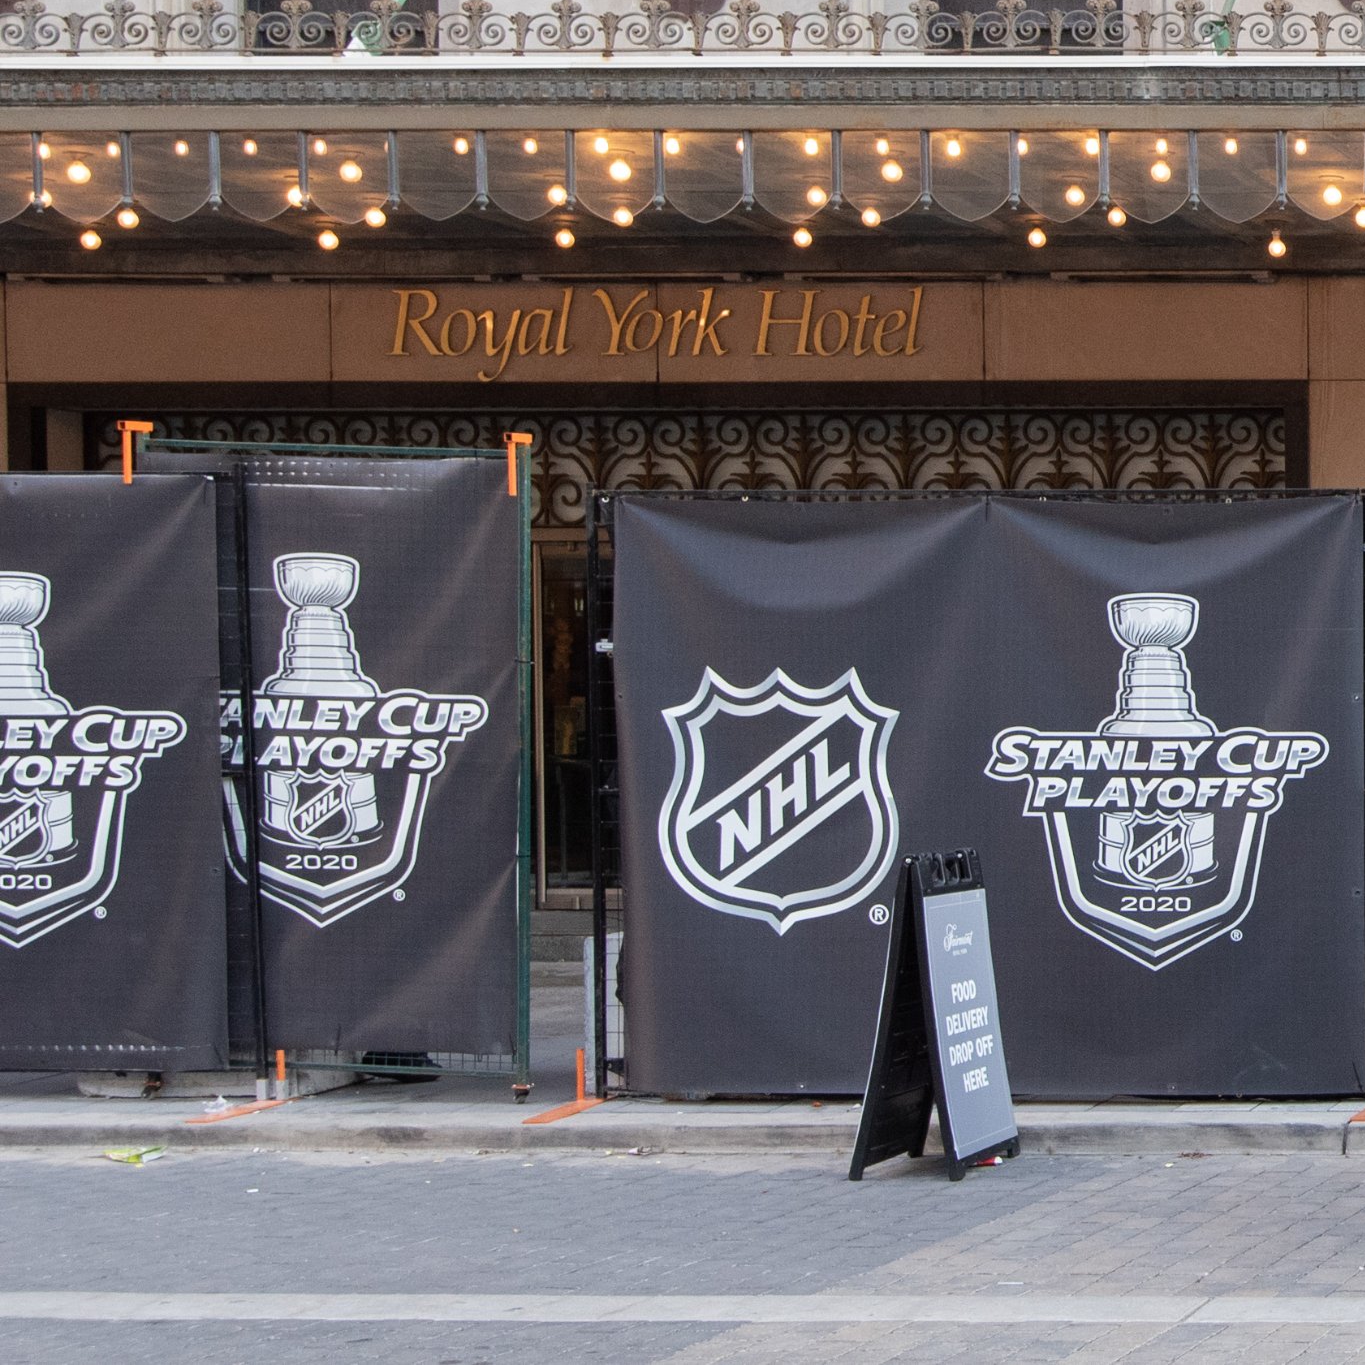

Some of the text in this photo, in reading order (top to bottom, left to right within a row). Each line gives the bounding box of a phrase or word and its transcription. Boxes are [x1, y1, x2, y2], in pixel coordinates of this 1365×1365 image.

[385, 286, 925, 382] Royal York Hotel
[994, 734, 1214, 773] STANLEY
[715, 739, 852, 873] NHL
[1033, 776, 1278, 808] PLAYOFFS
[300, 791, 341, 832] NHL
[285, 854, 358, 870] 2020
[1136, 830, 1180, 874] NHL
[1120, 896, 1192, 912] 2020
[951, 980, 977, 1004] FOOD
[945, 1005, 989, 1036] DELIVERY
[949, 1034, 994, 1067] DROP OFF
[963, 1066, 990, 1093] HERE
